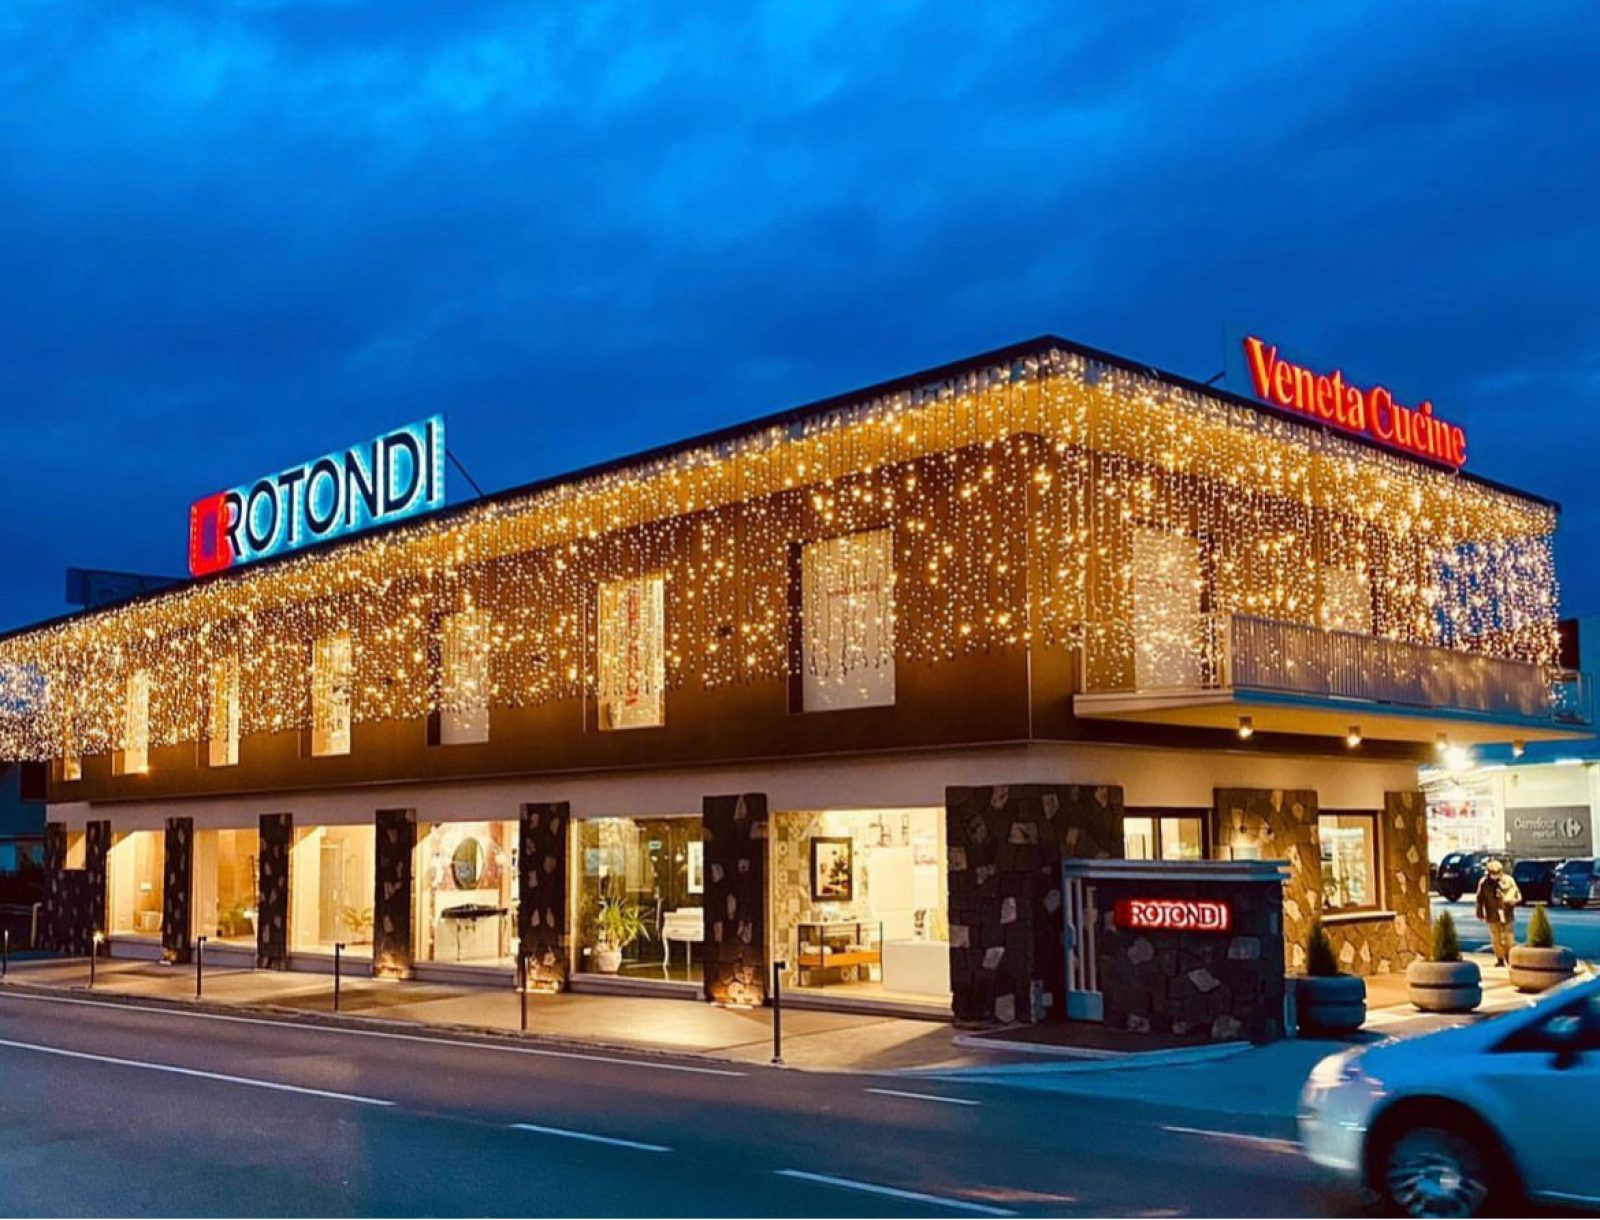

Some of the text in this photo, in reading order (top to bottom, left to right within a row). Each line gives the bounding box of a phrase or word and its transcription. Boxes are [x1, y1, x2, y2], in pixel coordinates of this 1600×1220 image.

[1244, 335, 1467, 467] Veneta Cucine
[222, 421, 434, 557] ROTONDI
[1130, 901, 1228, 930] ROTONDI
